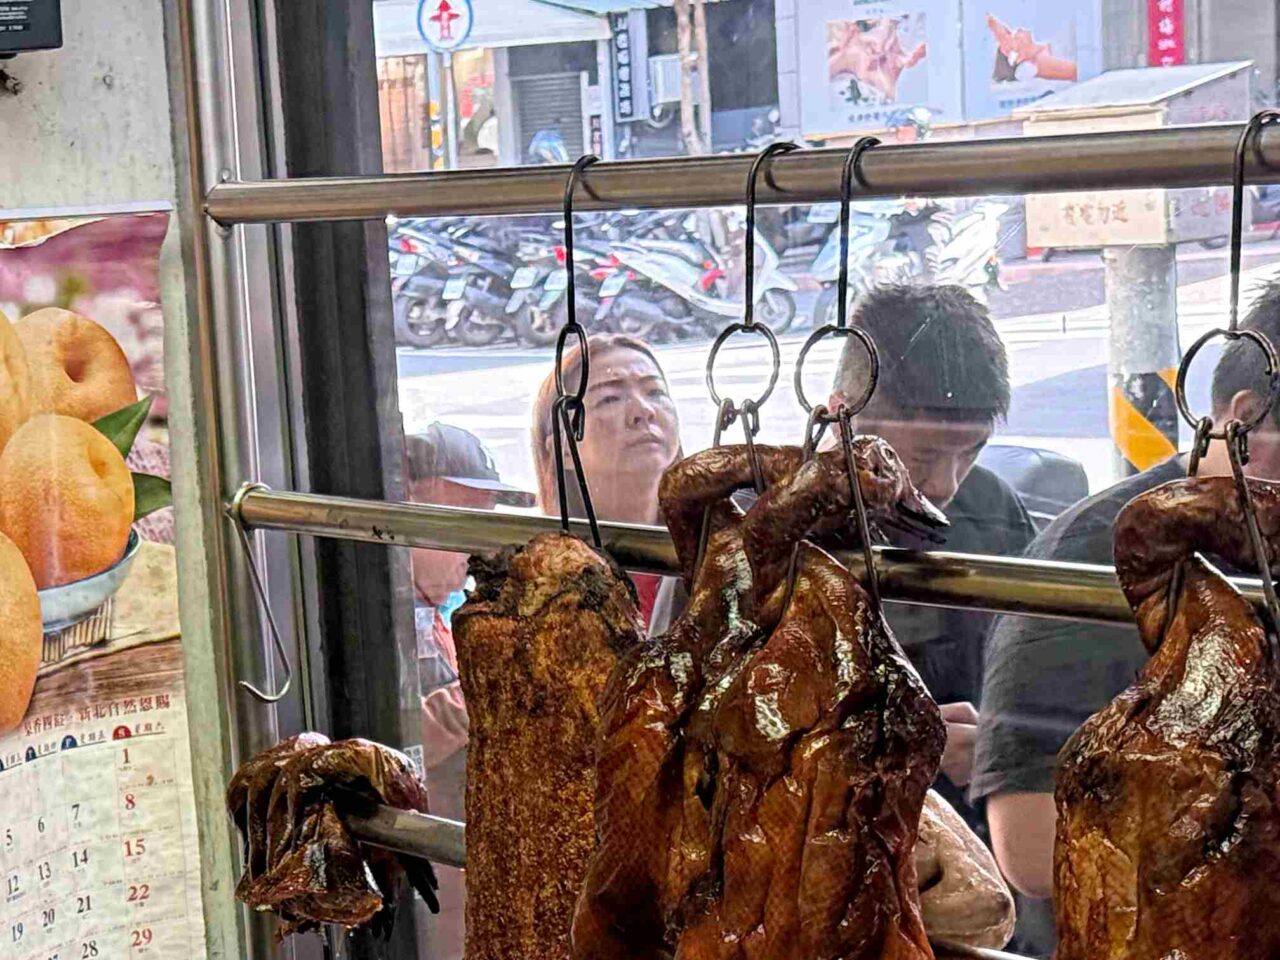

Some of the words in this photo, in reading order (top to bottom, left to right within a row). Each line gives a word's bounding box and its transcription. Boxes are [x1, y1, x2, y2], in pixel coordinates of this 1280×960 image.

[123, 748, 130, 764] 1
[6, 829, 12, 846] 5
[38, 816, 45, 833] 6
[72, 803, 80, 820] 7
[125, 793, 135, 810] 8
[8, 875, 19, 895] 12
[38, 861, 51, 880] 13
[72, 848, 89, 868] 14
[124, 838, 146, 857] 15
[12, 922, 23, 942] 19
[43, 908, 55, 927] 20
[77, 895, 91, 914] 21
[127, 884, 149, 902] 22
[82, 940, 98, 959] 28
[131, 928, 152, 947] 29
